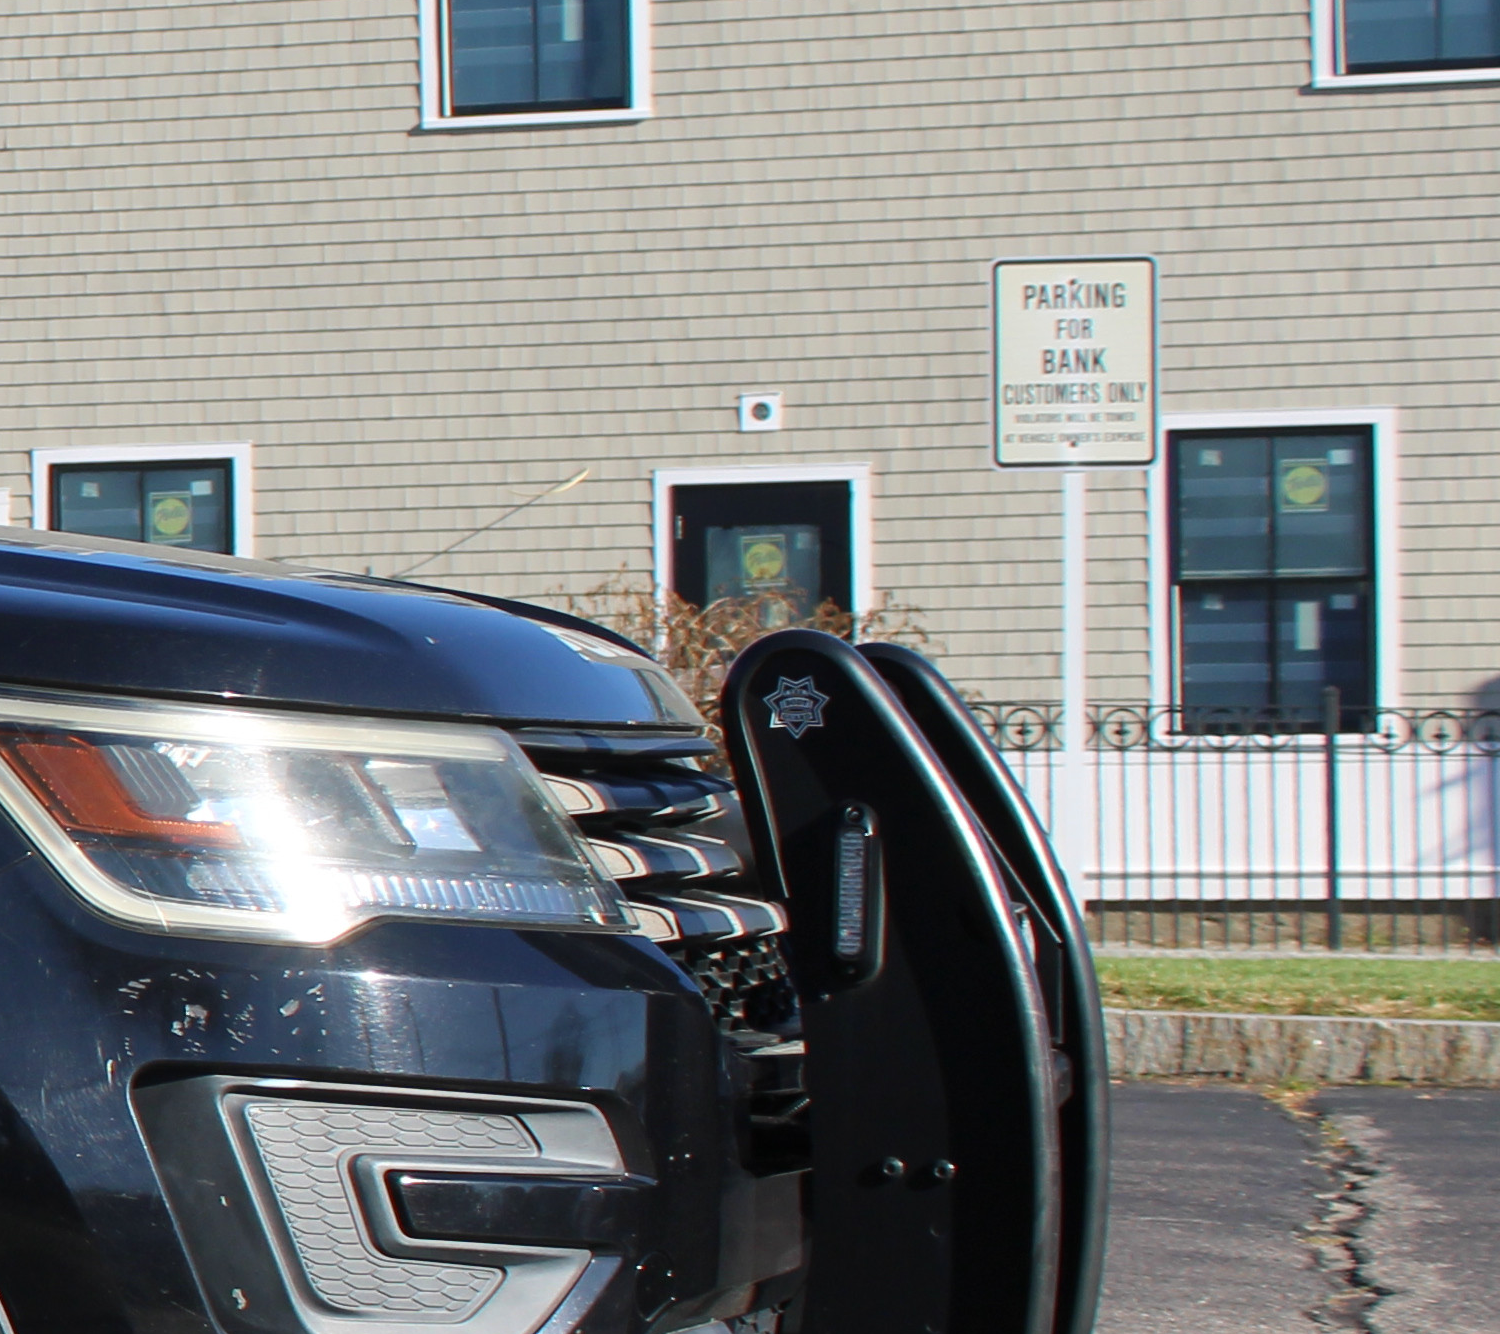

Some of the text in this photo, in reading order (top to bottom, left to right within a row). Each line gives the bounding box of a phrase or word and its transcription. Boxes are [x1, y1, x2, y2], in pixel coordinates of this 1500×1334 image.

[1022, 282, 1127, 310] PARKING
[1055, 319, 1093, 340] FOR
[1041, 348, 1107, 374] BANK
[1003, 382, 1148, 405] CUSTOMERS ONLY
